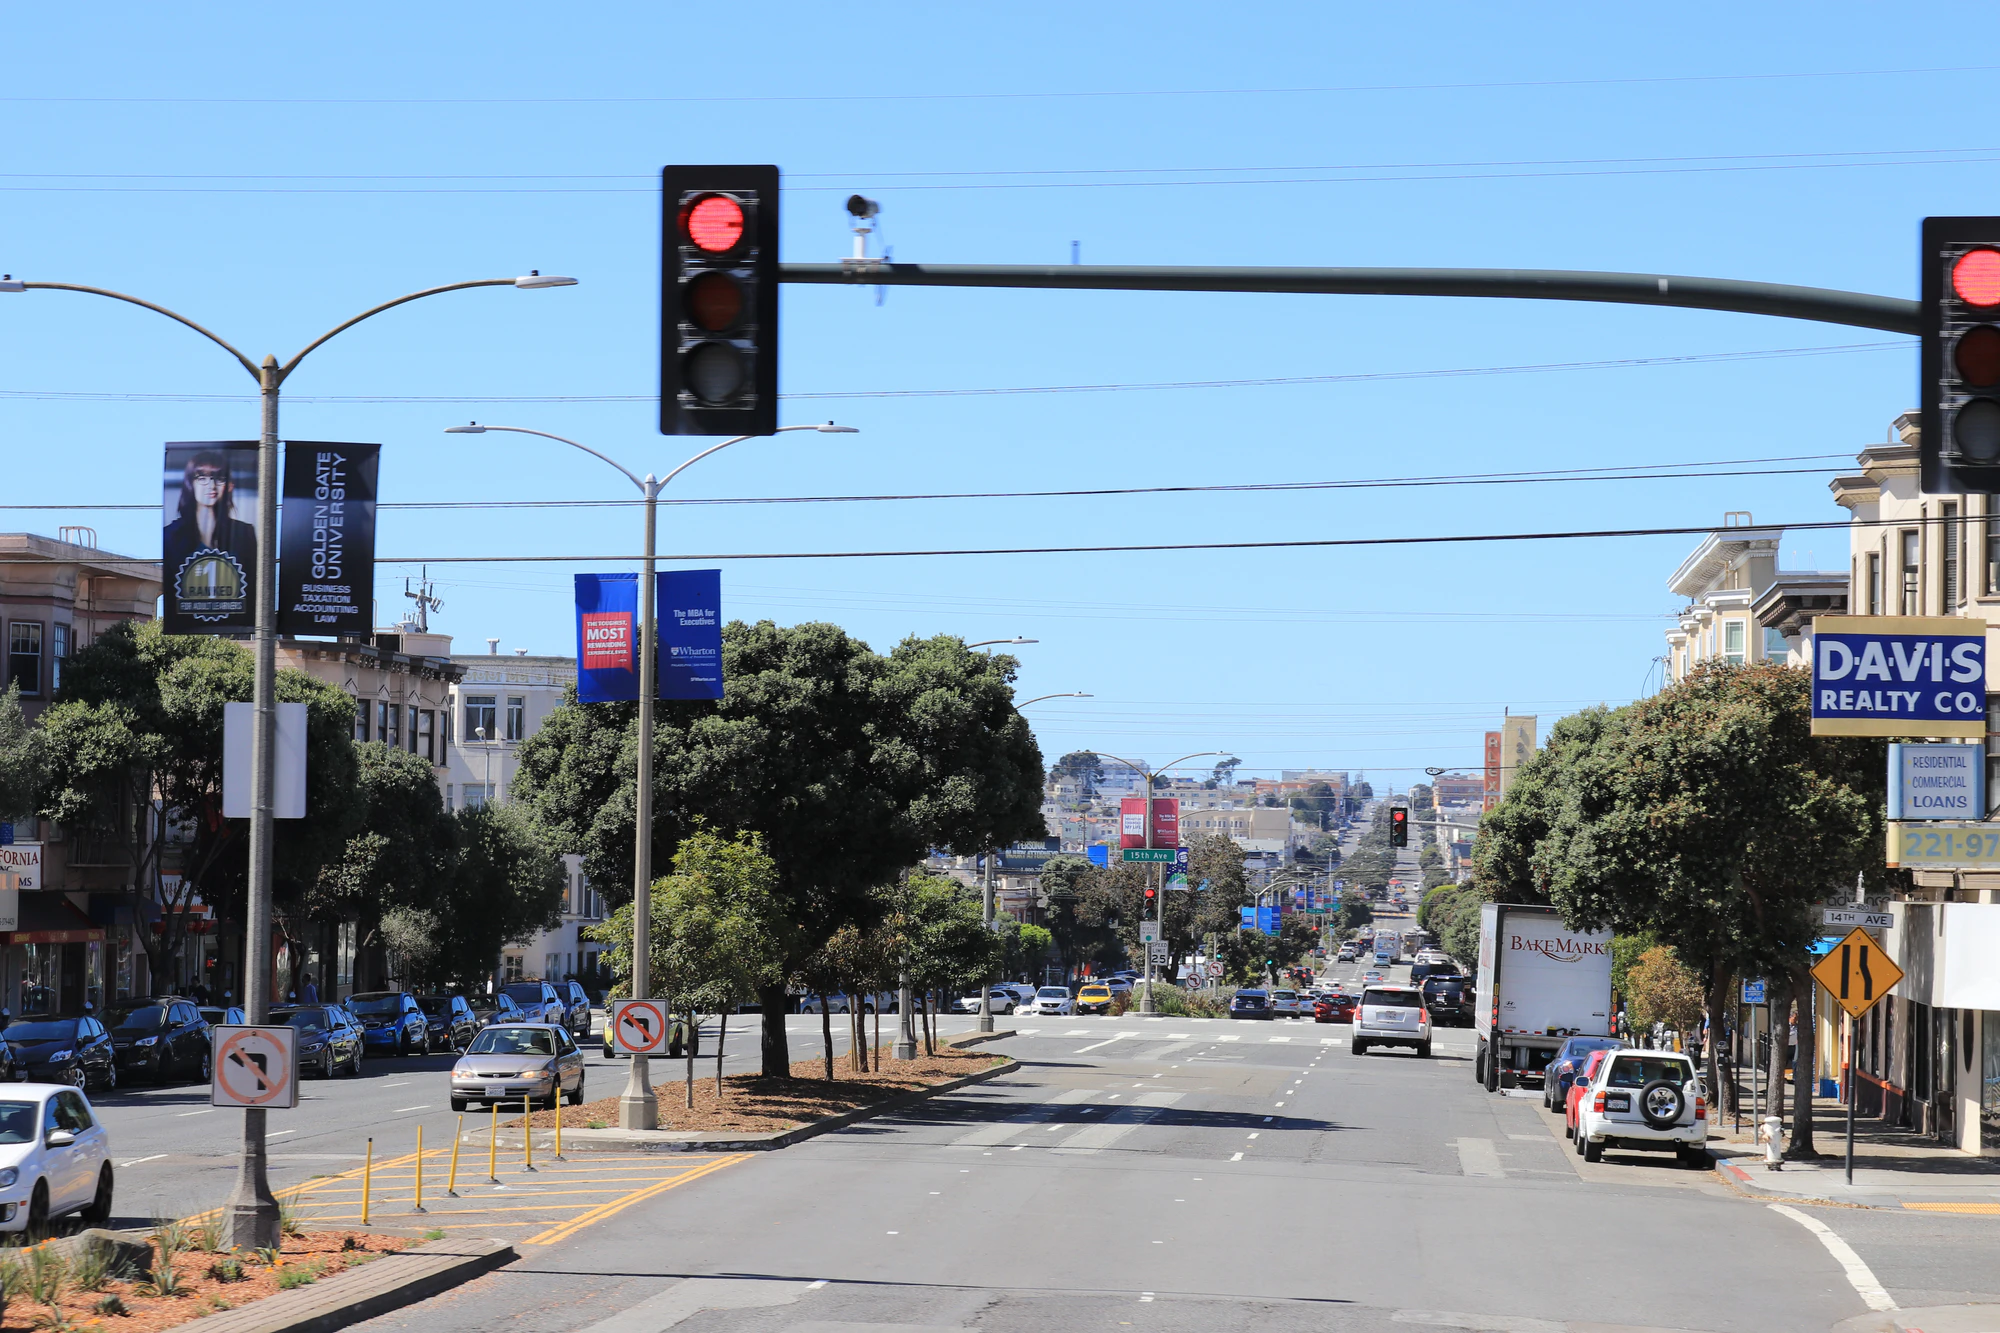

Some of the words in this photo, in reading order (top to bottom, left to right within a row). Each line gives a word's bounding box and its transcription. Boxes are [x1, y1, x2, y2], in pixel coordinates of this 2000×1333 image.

[315, 452, 332, 500] GATE
[328, 453, 347, 579] UNIVERSITY
[312, 505, 328, 579] GOLDEN
[195, 561, 217, 598] #1
[302, 584, 351, 593] BUSINESS
[302, 594, 351, 603] TAXATION
[293, 604, 358, 613] ACCOUNTING
[673, 609, 686, 617] The
[687, 609, 704, 617] MBA
[314, 615, 337, 623] LAW
[680, 617, 715, 625] Executives
[587, 628, 627, 640] MOST
[679, 646, 716, 655] Wharton
[1820, 690, 1921, 712] REALTY
[1934, 691, 1983, 713] CO.
[1912, 756, 1967, 769] RESIDENTIAL
[1487, 737, 1499, 807] ALEXA
[1912, 776, 1967, 788] COMMERCIAL
[1913, 795, 1968, 808] LOANS
[1906, 833, 2000, 857] 221-97
[1831, 913, 1855, 922] 14TH
[1865, 915, 1888, 925] AVE
[1151, 954, 1167, 964] 25
